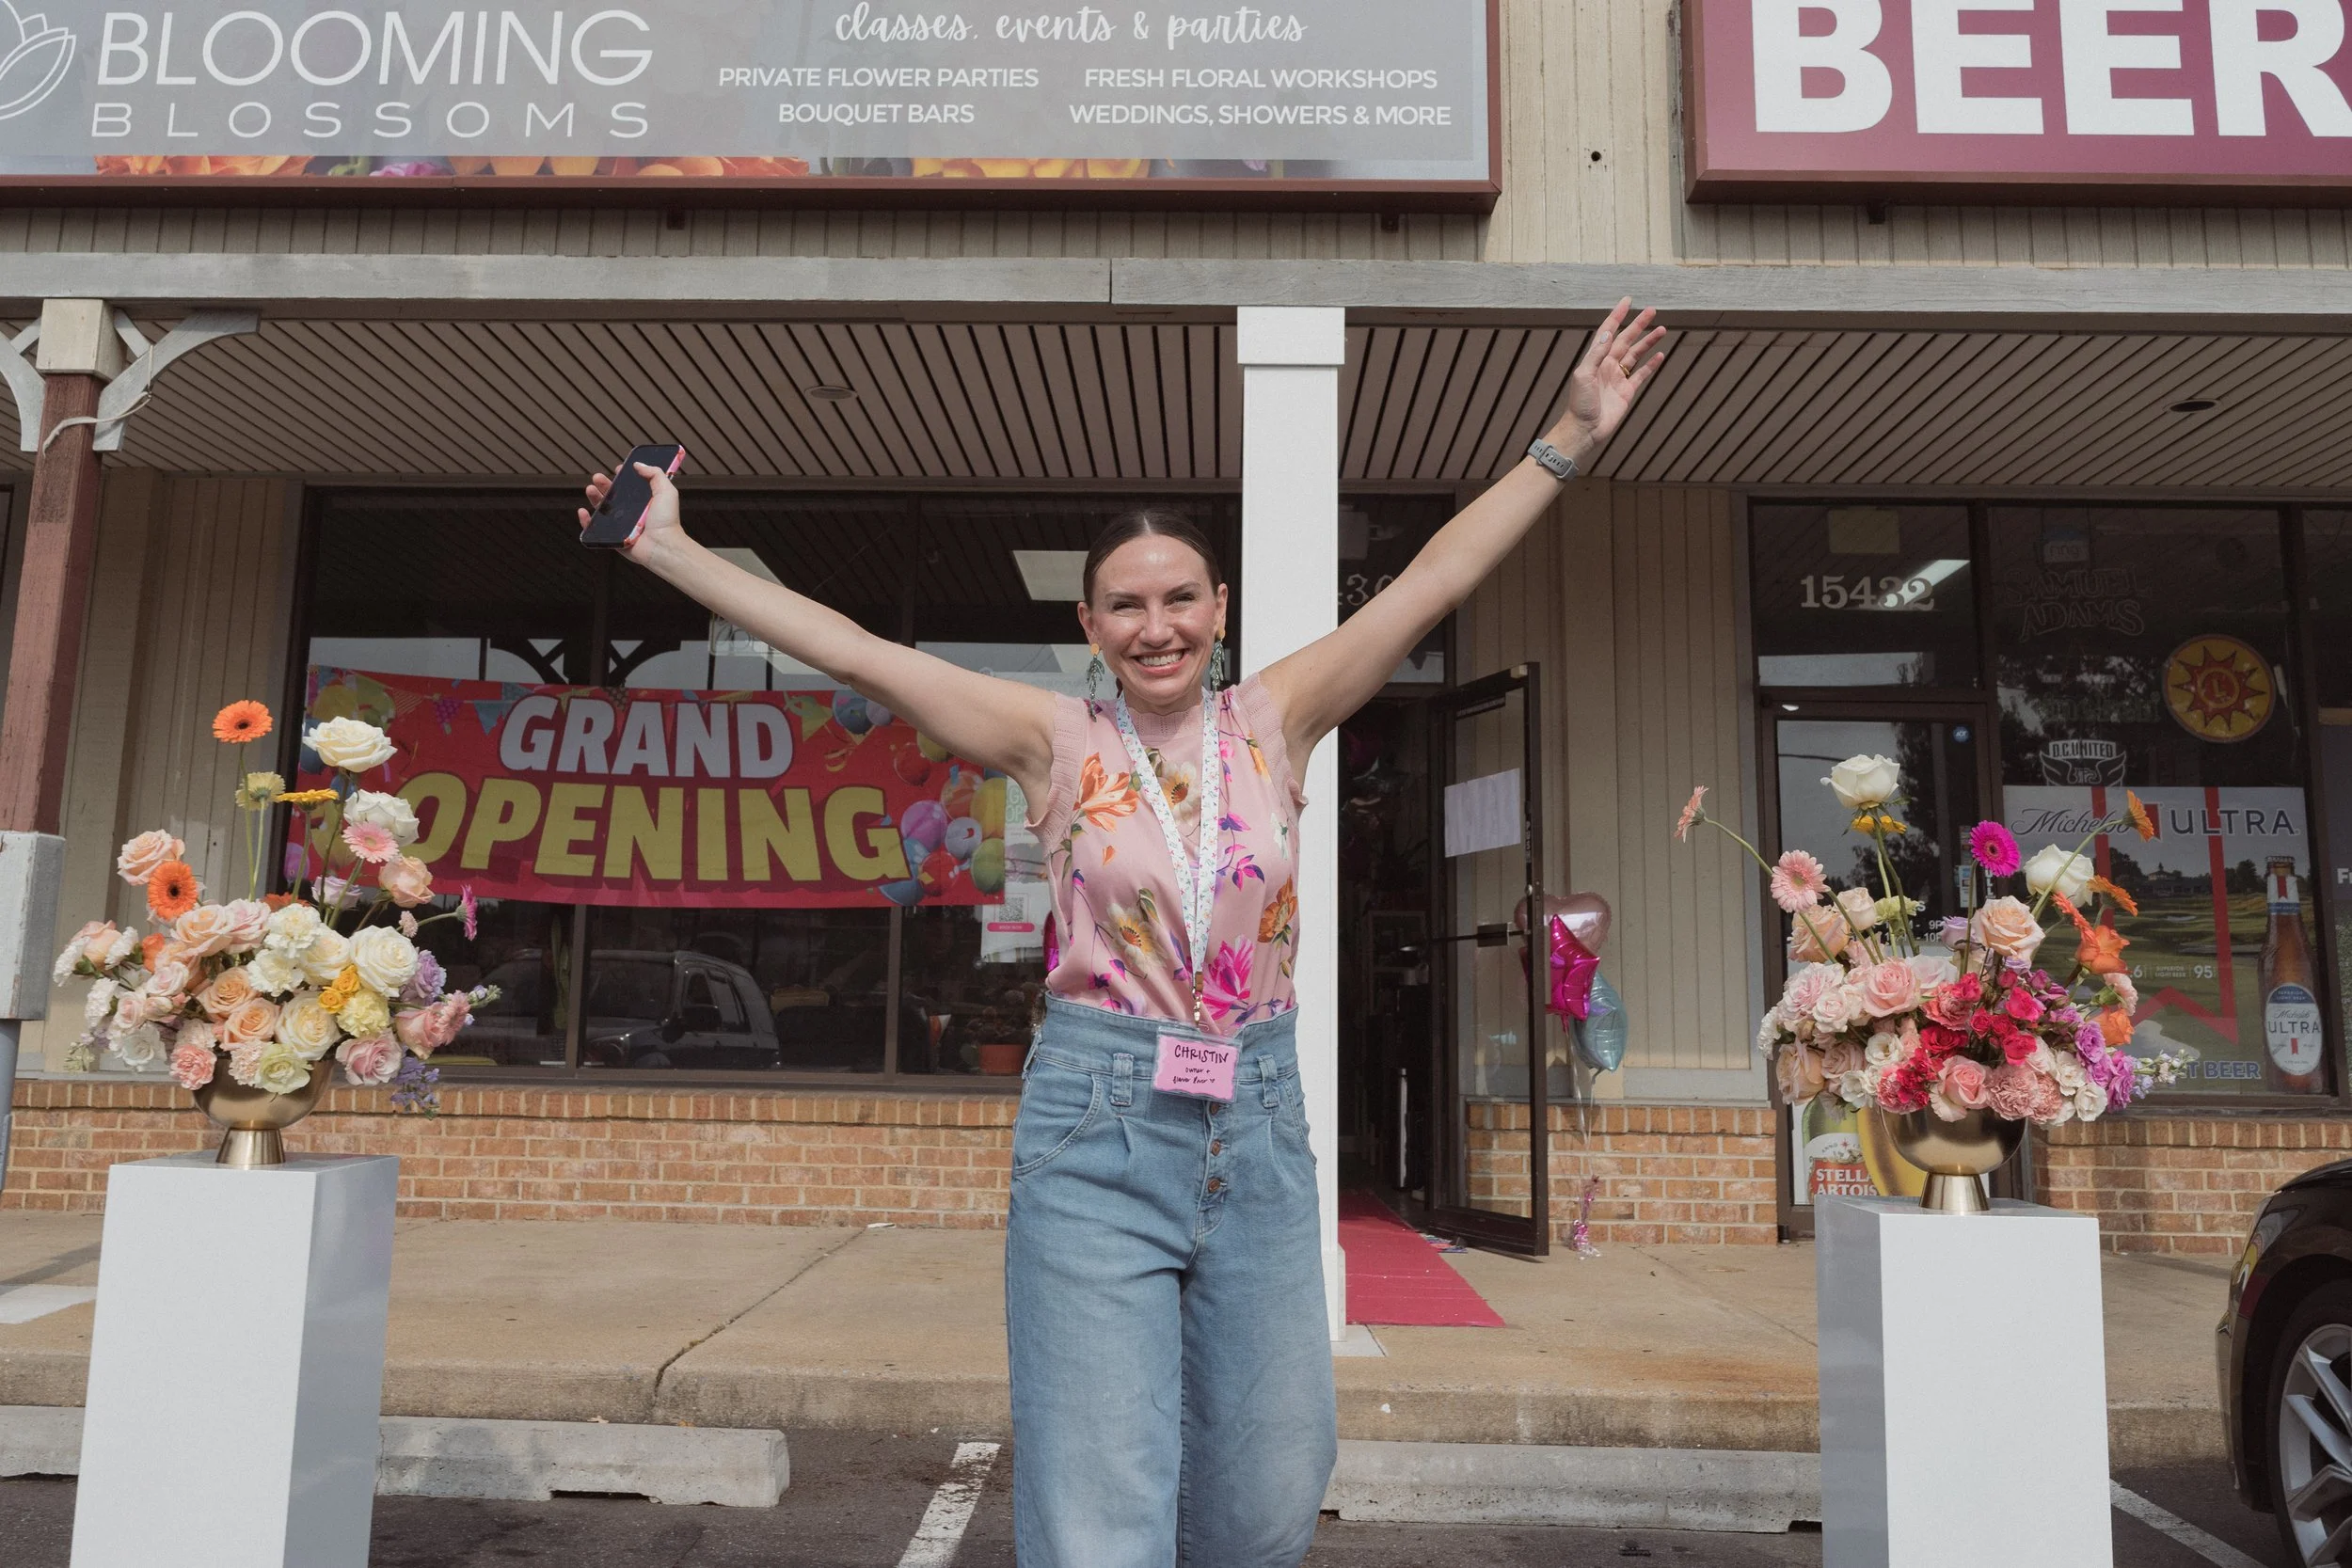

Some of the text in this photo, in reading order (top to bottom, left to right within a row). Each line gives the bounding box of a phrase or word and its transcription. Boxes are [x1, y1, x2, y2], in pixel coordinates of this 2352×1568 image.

[995, 6, 1117, 43] events
[1133, 10, 1150, 40] &
[1168, 6, 1309, 51] parties
[97, 9, 654, 87] BLOOMING
[719, 67, 1040, 87] PRIVATE FLOWER PARTIES
[1085, 69, 1438, 88] FRESH FLORAL WORKSHOPS
[1752, 0, 2352, 137] BEER
[91, 102, 649, 138] BLOSSOMS
[779, 103, 975, 126] BOUQUET BARS
[1070, 104, 1452, 126] WEDDINGS, SHOWERS & MORE
[1801, 576, 1935, 610] 15432
[2002, 564, 2153, 607] SAMUEL
[2019, 599, 2146, 642] ADAMS
[499, 696, 793, 779] GRAND
[390, 771, 912, 884] OPENING
[2170, 809, 2296, 835] ULTRA
[2194, 964, 2214, 978] 95
[2268, 1022, 2321, 1034] ULTRA
[1175, 1044, 1229, 1064] CHRISTIN
[2203, 1061, 2262, 1080] BEER
[1817, 1183, 1878, 1196] ARTOIS
